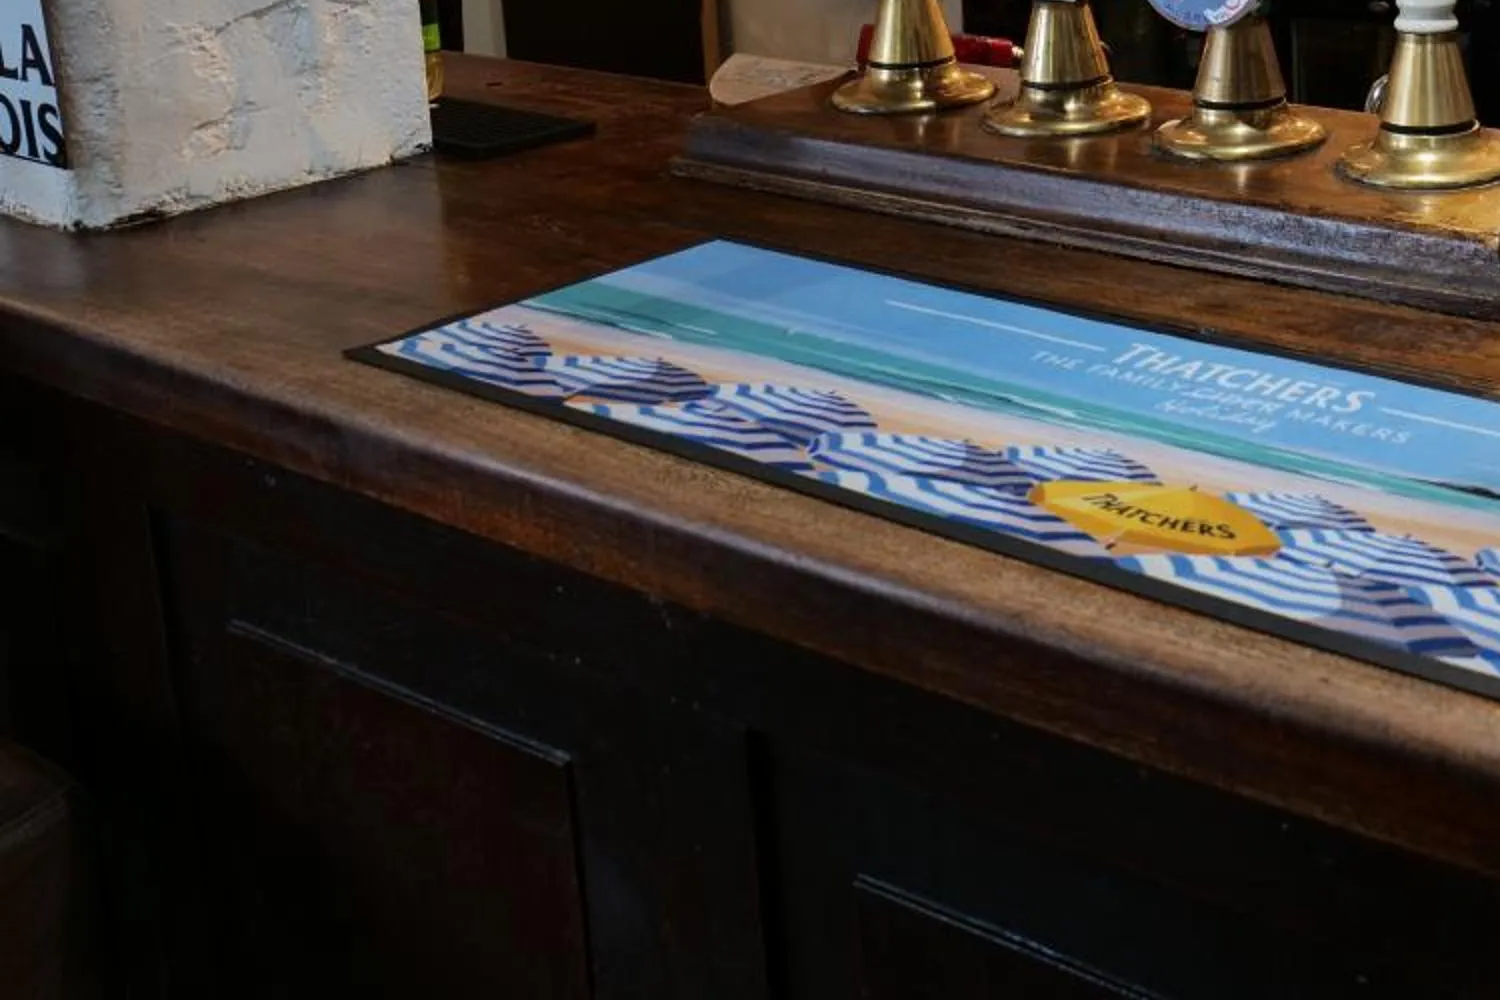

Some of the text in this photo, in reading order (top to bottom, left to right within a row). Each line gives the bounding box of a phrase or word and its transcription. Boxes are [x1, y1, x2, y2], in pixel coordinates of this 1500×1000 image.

[1032, 350, 1088, 370] THE
[1088, 363, 1184, 392] FAMILY
[1287, 408, 1413, 445] MAKERS
[1112, 343, 1376, 413] THATCHERS
[1081, 492, 1238, 540] THATCHERS
